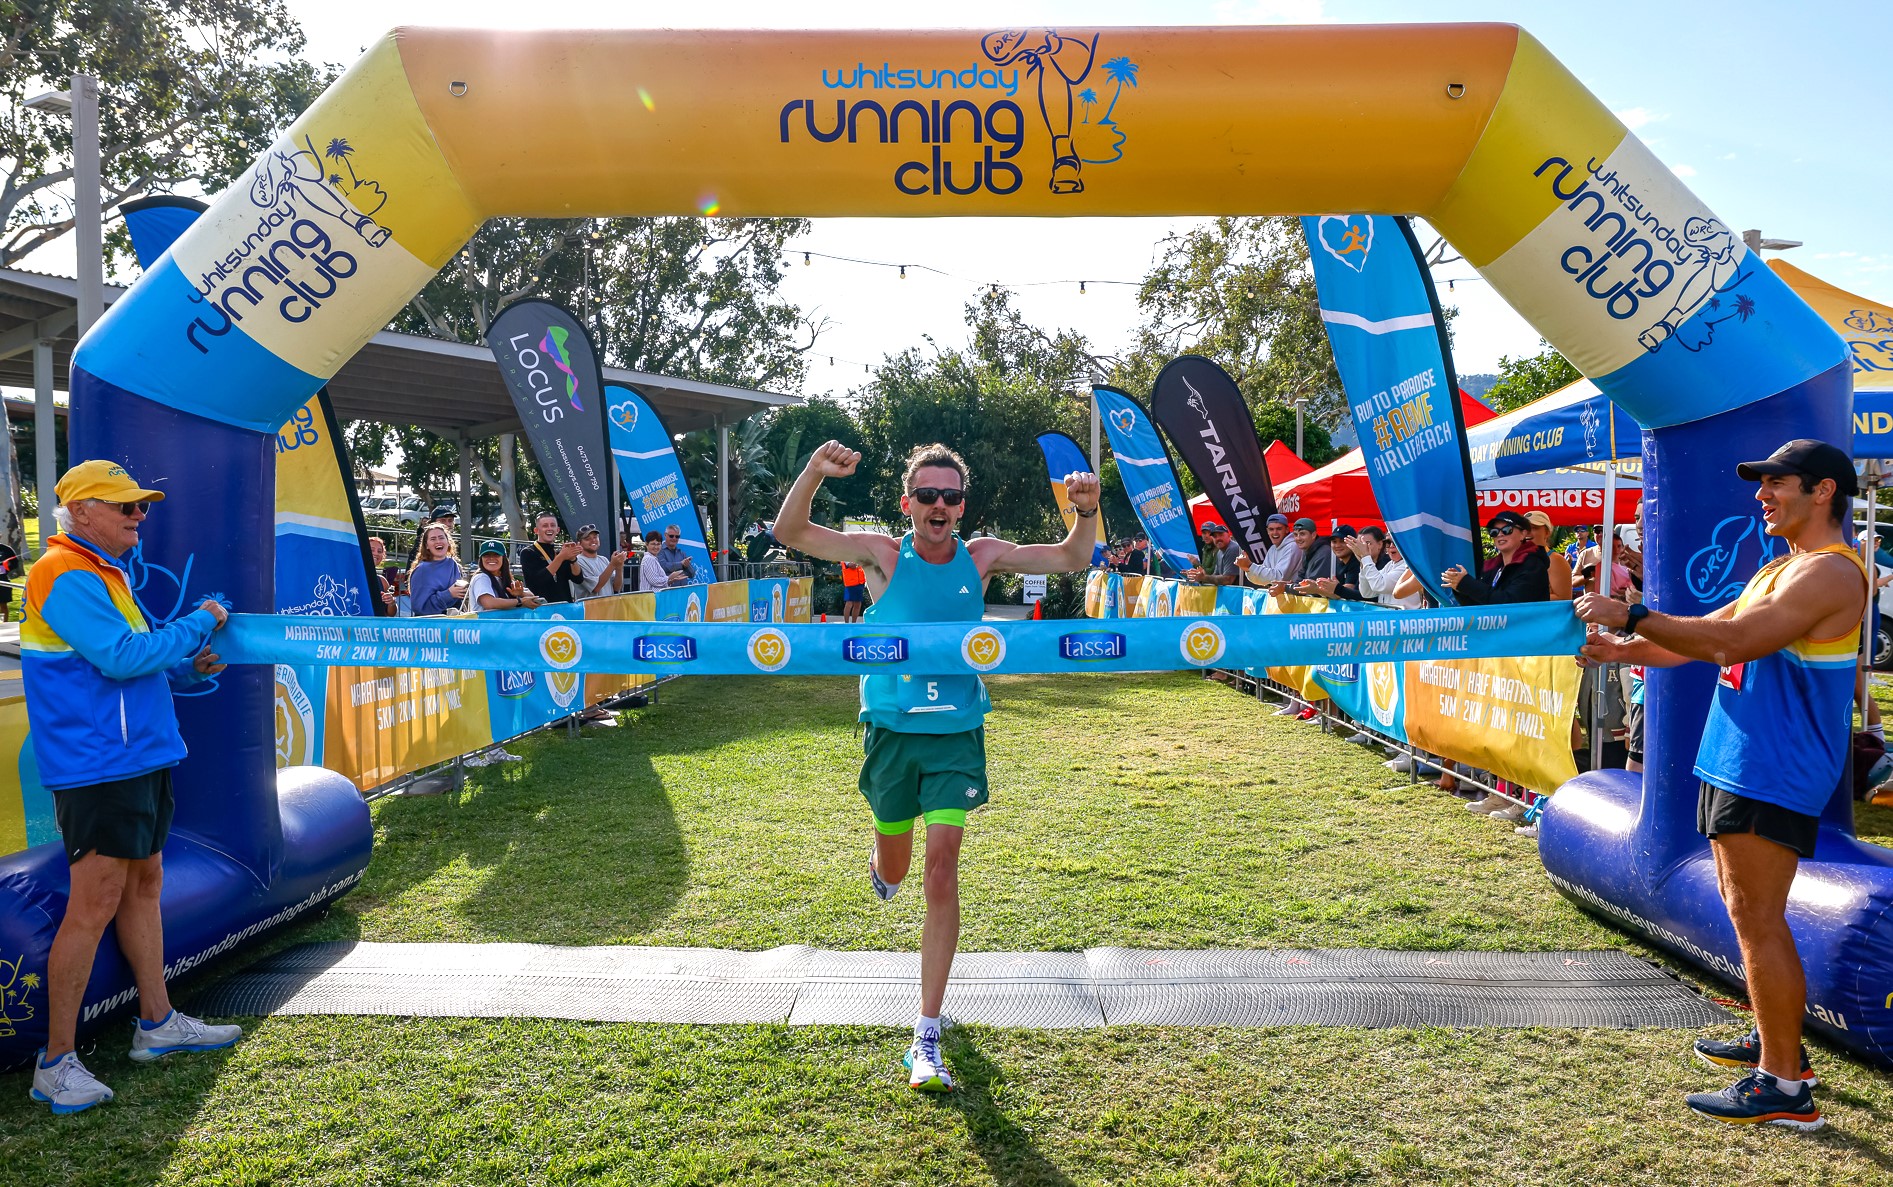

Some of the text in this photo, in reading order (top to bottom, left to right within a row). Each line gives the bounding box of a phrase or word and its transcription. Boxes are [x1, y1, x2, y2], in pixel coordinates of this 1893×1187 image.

[823, 63, 1018, 96] whitsunday
[780, 100, 1024, 159] running
[894, 146, 1023, 195] club
[1533, 157, 1675, 298] running
[1587, 157, 1692, 266] whitsunday
[187, 201, 297, 304] whitsunday
[186, 219, 332, 354] running
[280, 251, 358, 323] club
[1561, 245, 1639, 320] club
[510, 333, 564, 424] LOCUS
[1355, 368, 1436, 424] RUN TO PARADISE
[1489, 433, 1531, 460] RUNNING
[1533, 427, 1565, 452] CLUB
[666, 495, 690, 514] BEACH
[1200, 419, 1268, 564] TARKINE
[1159, 505, 1184, 524] BEACH
[1698, 548, 1729, 590] WRC
[285, 626, 344, 642] MARATHON
[354, 627, 380, 643] HALF
[383, 628, 442, 644] MARATHON
[452, 629, 481, 645] 10KM
[1064, 636, 1121, 657] tassal
[1289, 621, 1355, 640] MARATHON
[1367, 620, 1396, 637] HALF
[1400, 616, 1464, 635] MARATHON
[1477, 615, 1508, 630] 10KM
[1327, 642, 1353, 657] 5KM
[1364, 640, 1390, 656] 2KM
[1402, 638, 1424, 653] 1KM
[1437, 635, 1468, 652] 1MILE
[316, 644, 341, 659] 5KM
[352, 646, 377, 661] 2KM
[388, 647, 410, 662] 1KM
[420, 647, 449, 663] 1MILE
[638, 639, 692, 659] tassal
[847, 640, 903, 660] tassal
[350, 676, 395, 707] MARATHON
[398, 670, 418, 695] HALF
[927, 681, 939, 701] 5
[1419, 663, 1460, 690] MARATHON
[1467, 671, 1490, 696] HALF
[1539, 688, 1564, 718] 10KM
[1608, 670, 1619, 682] A
[377, 705, 395, 731] 5KM
[398, 699, 417, 724] 2KM
[1440, 694, 1457, 718] 5KM
[1463, 700, 1482, 725] 2KM
[1490, 706, 1507, 731] 1KM
[1515, 711, 1546, 740] 1MILE
[83, 866, 368, 1022] www.hitsundayrunningclub.com.au
